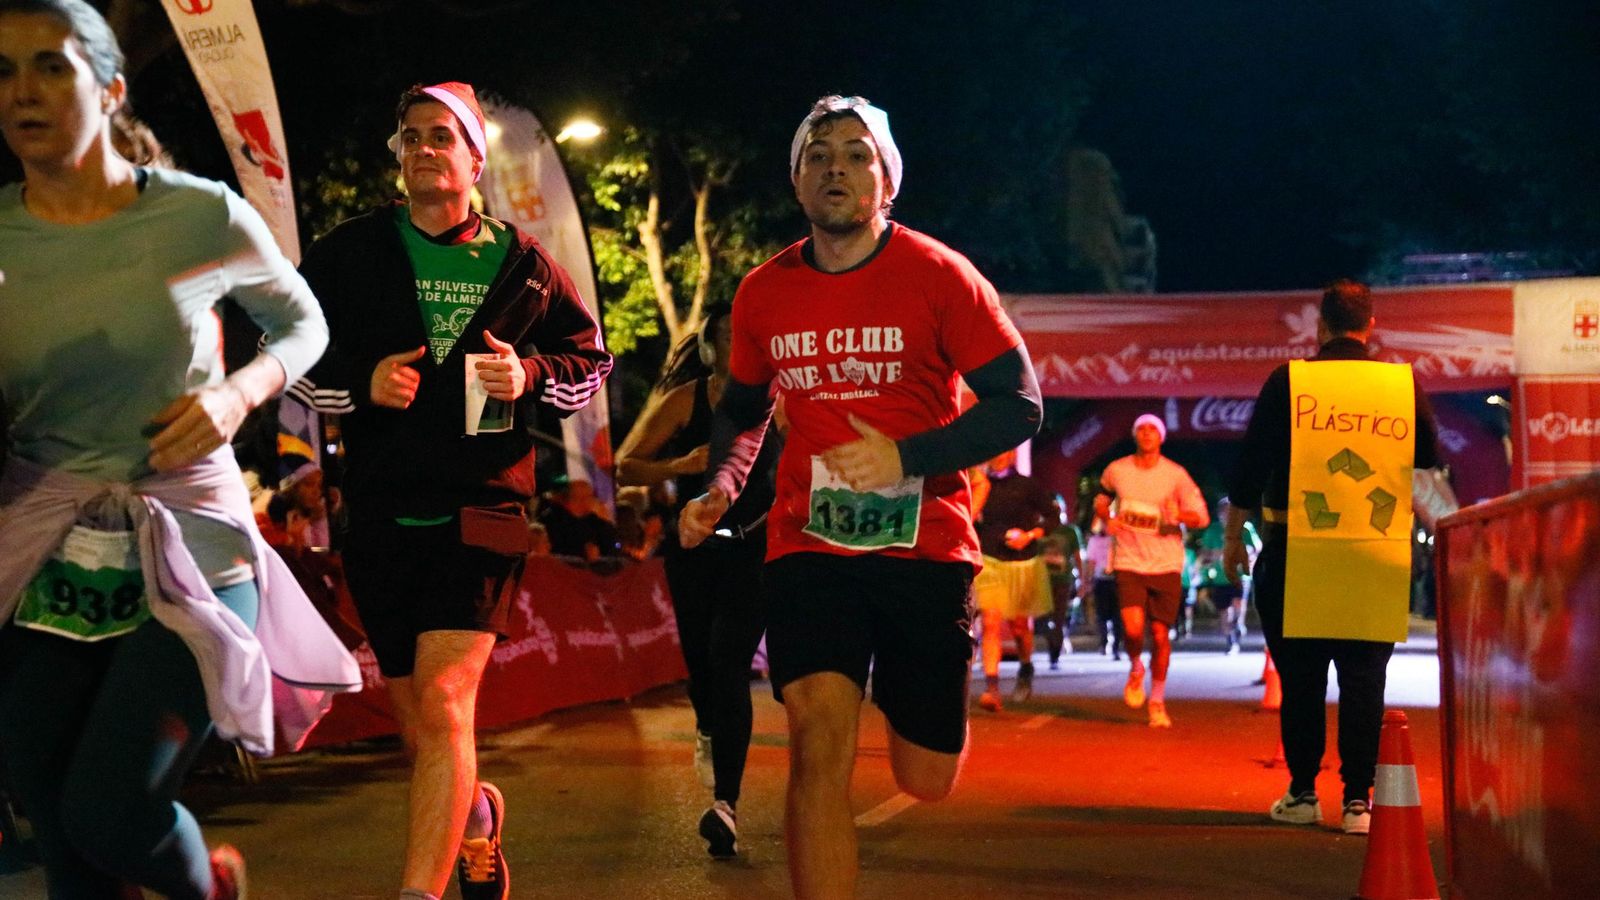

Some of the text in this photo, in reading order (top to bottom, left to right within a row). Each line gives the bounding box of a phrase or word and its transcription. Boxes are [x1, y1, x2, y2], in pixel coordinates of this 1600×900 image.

[425, 291, 441, 302] DE
[770, 327, 904, 360] ONE CLUB
[780, 365, 823, 390] ONE
[1296, 394, 1408, 440] PLÁSTICO
[816, 501, 905, 537] 1381
[48, 579, 145, 624] 938
